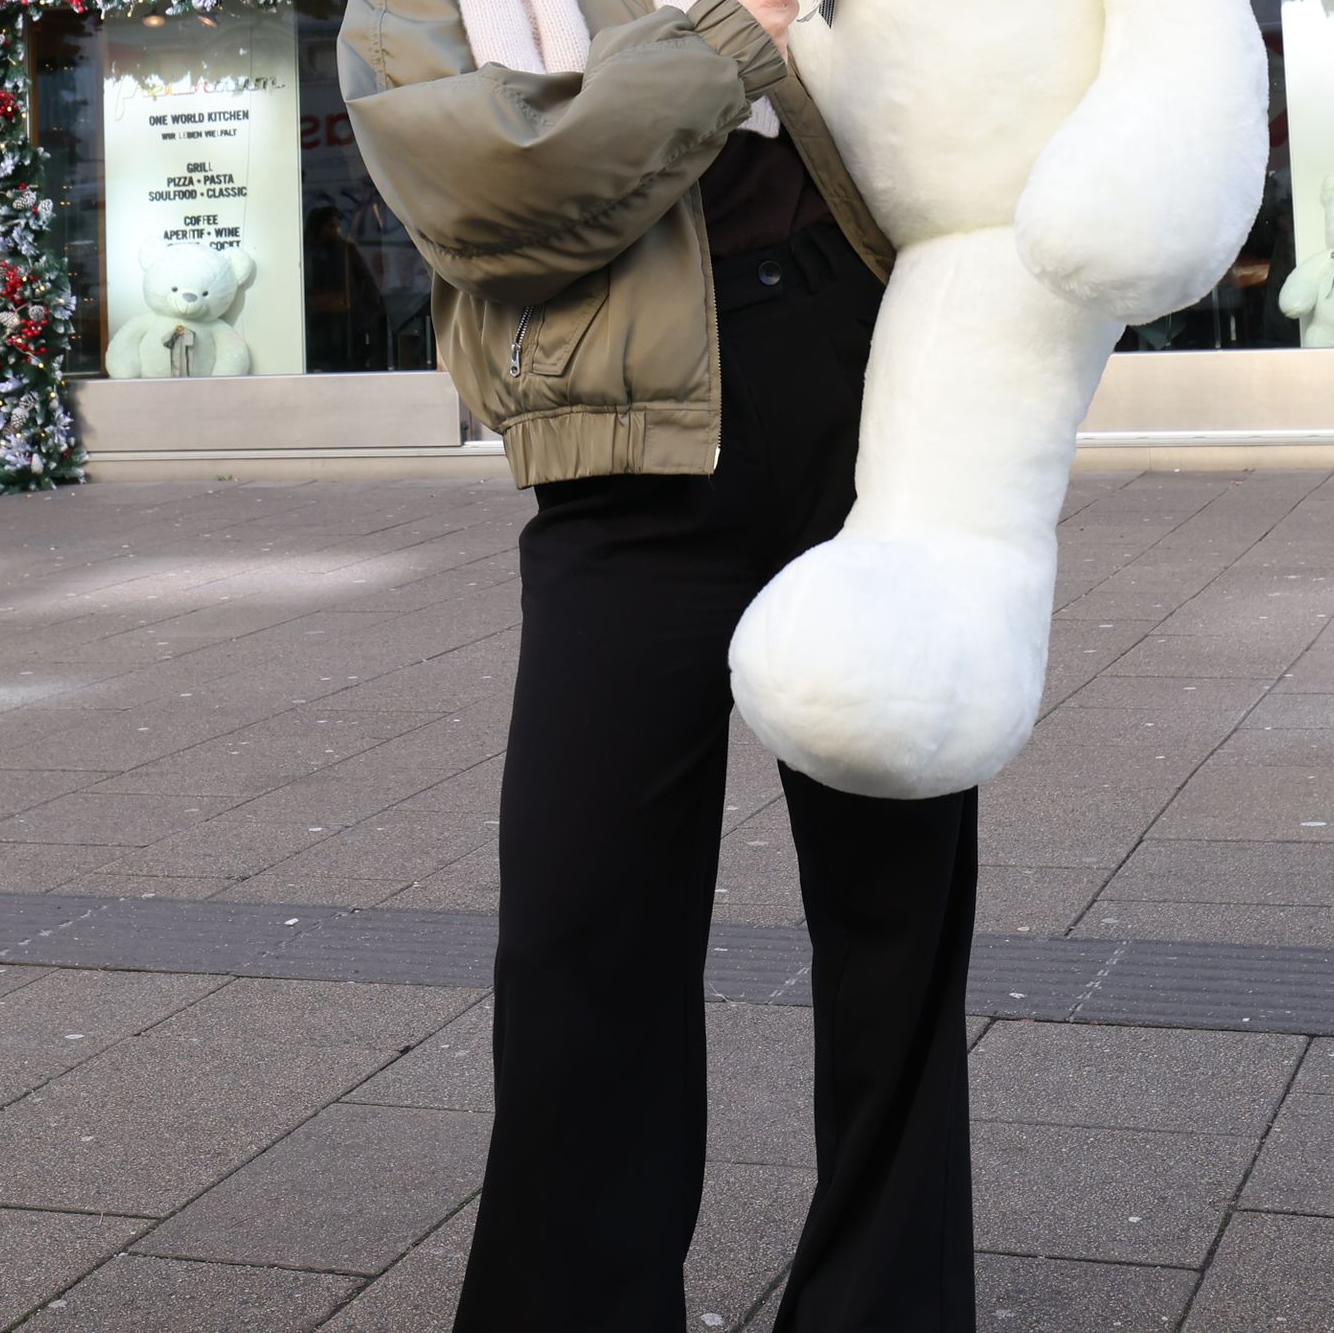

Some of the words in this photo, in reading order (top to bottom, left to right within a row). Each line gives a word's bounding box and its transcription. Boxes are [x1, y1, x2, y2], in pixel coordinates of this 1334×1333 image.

[148, 115, 169, 126] ONE
[171, 112, 205, 125] WORLD
[207, 109, 250, 123] KITCHEN
[186, 162, 213, 174] GRILL
[167, 176, 195, 187] PIZZA
[203, 173, 235, 186] PASTA
[148, 189, 198, 202] SOULFOOD
[206, 186, 248, 199] CLASSIC
[183, 214, 219, 226] COFFEE
[163, 228, 206, 240] APERITIF
[214, 226, 241, 238] WINE
